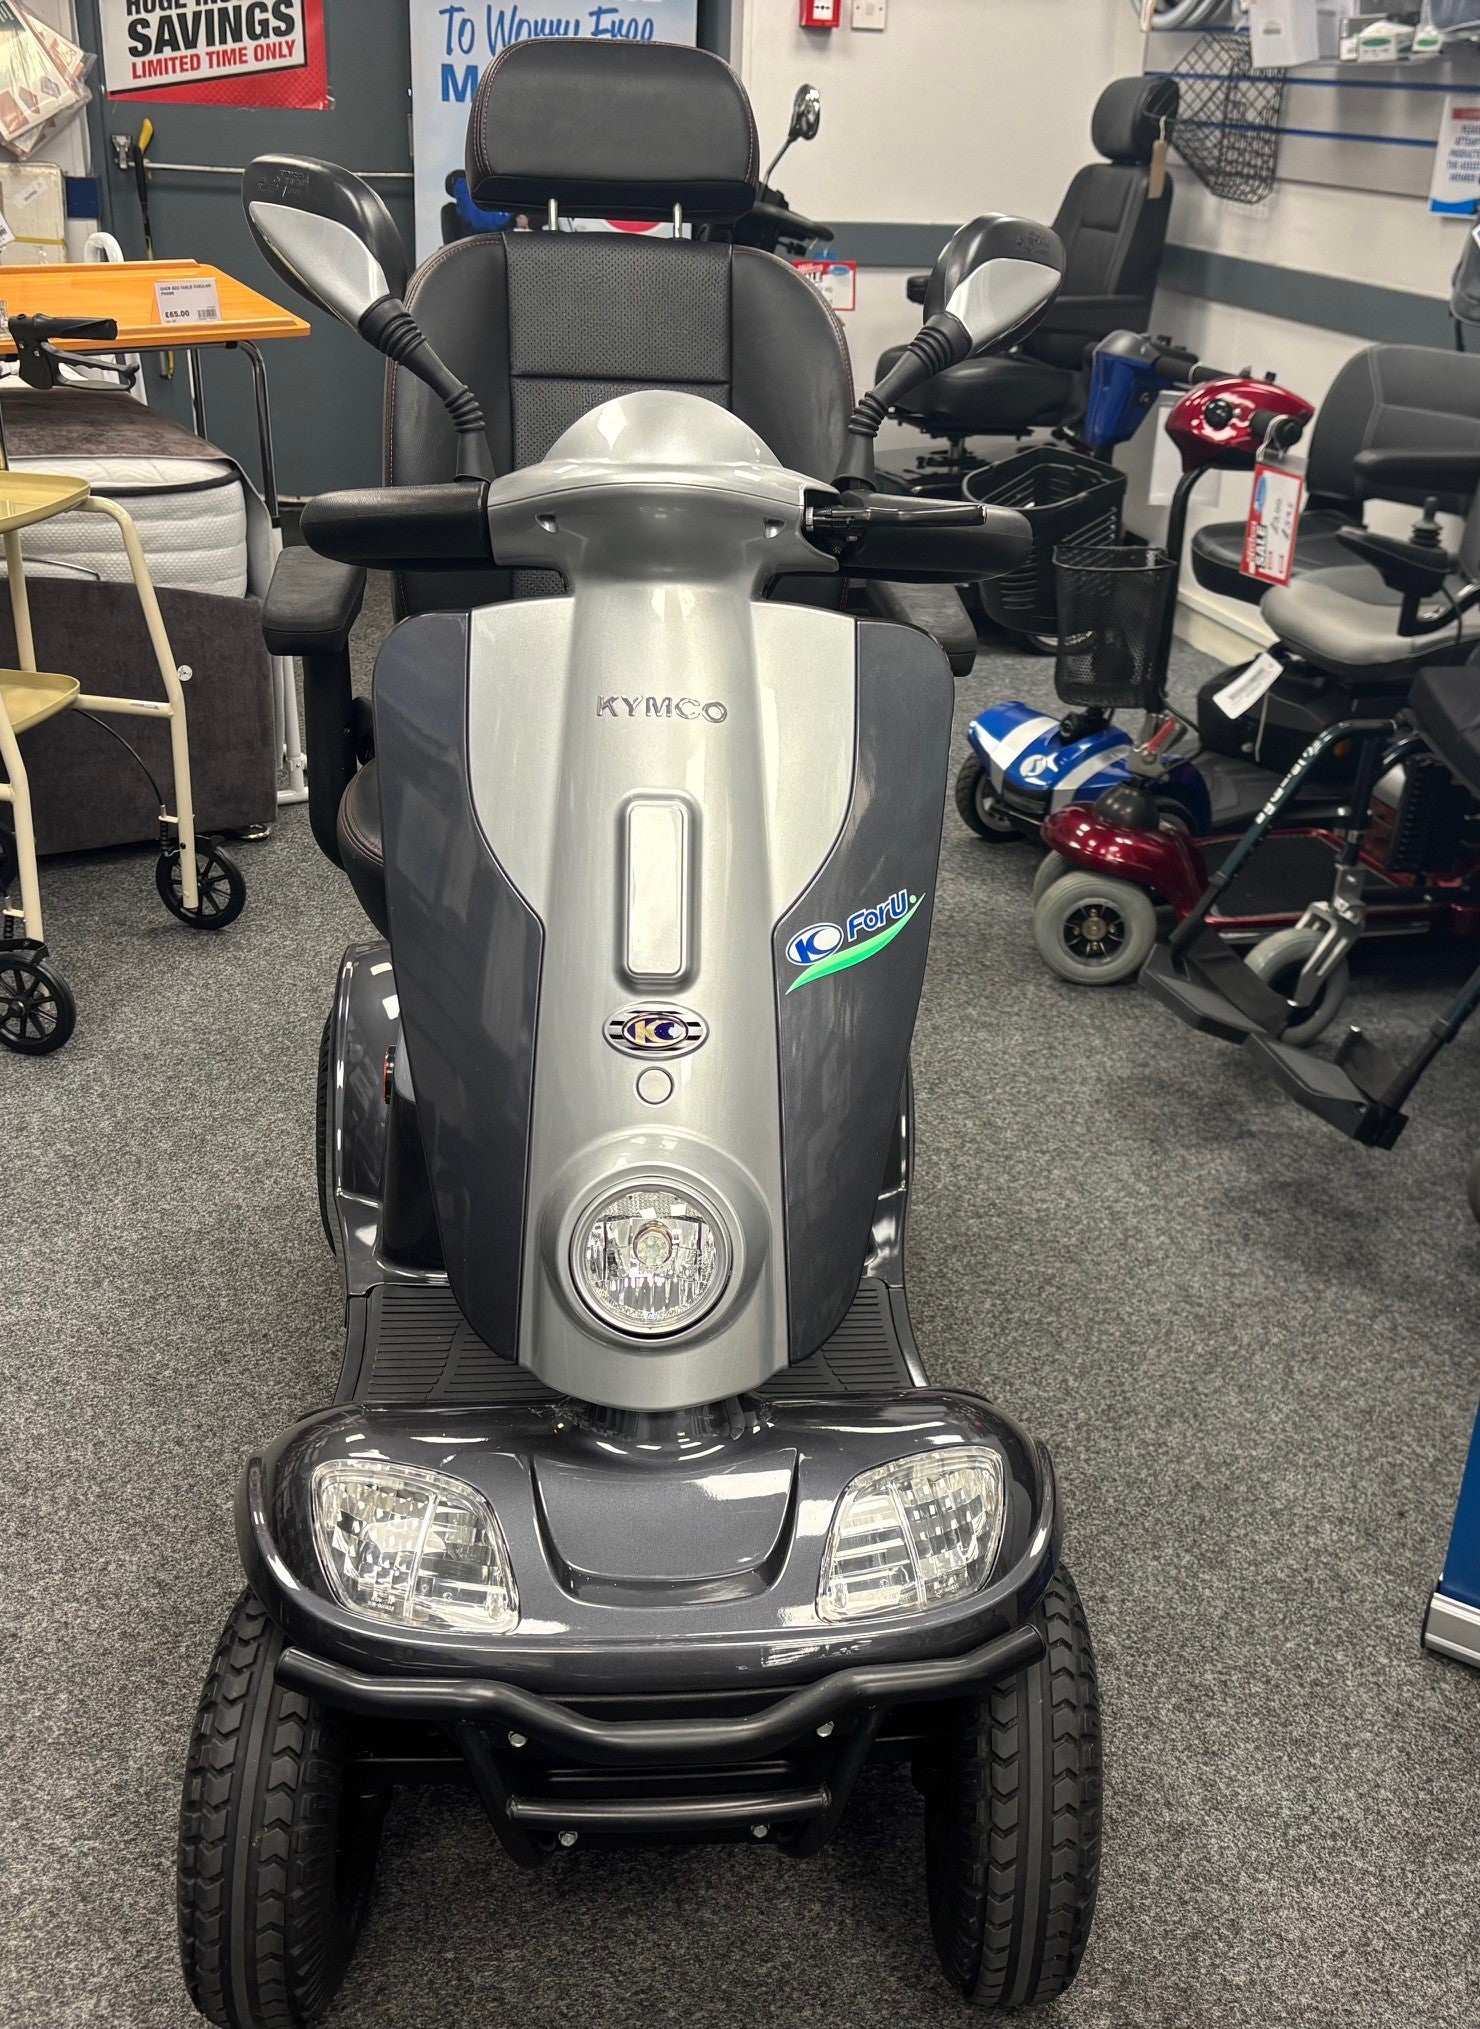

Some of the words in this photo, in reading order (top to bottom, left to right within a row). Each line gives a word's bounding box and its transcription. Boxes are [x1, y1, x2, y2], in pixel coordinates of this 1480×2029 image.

[127, 1, 296, 58] SAVINGS
[439, 5, 475, 55] To
[132, 52, 200, 80] LIMITED
[205, 47, 248, 69] TIME
[254, 39, 296, 62] ONLY
[596, 695, 728, 724] KYMCO
